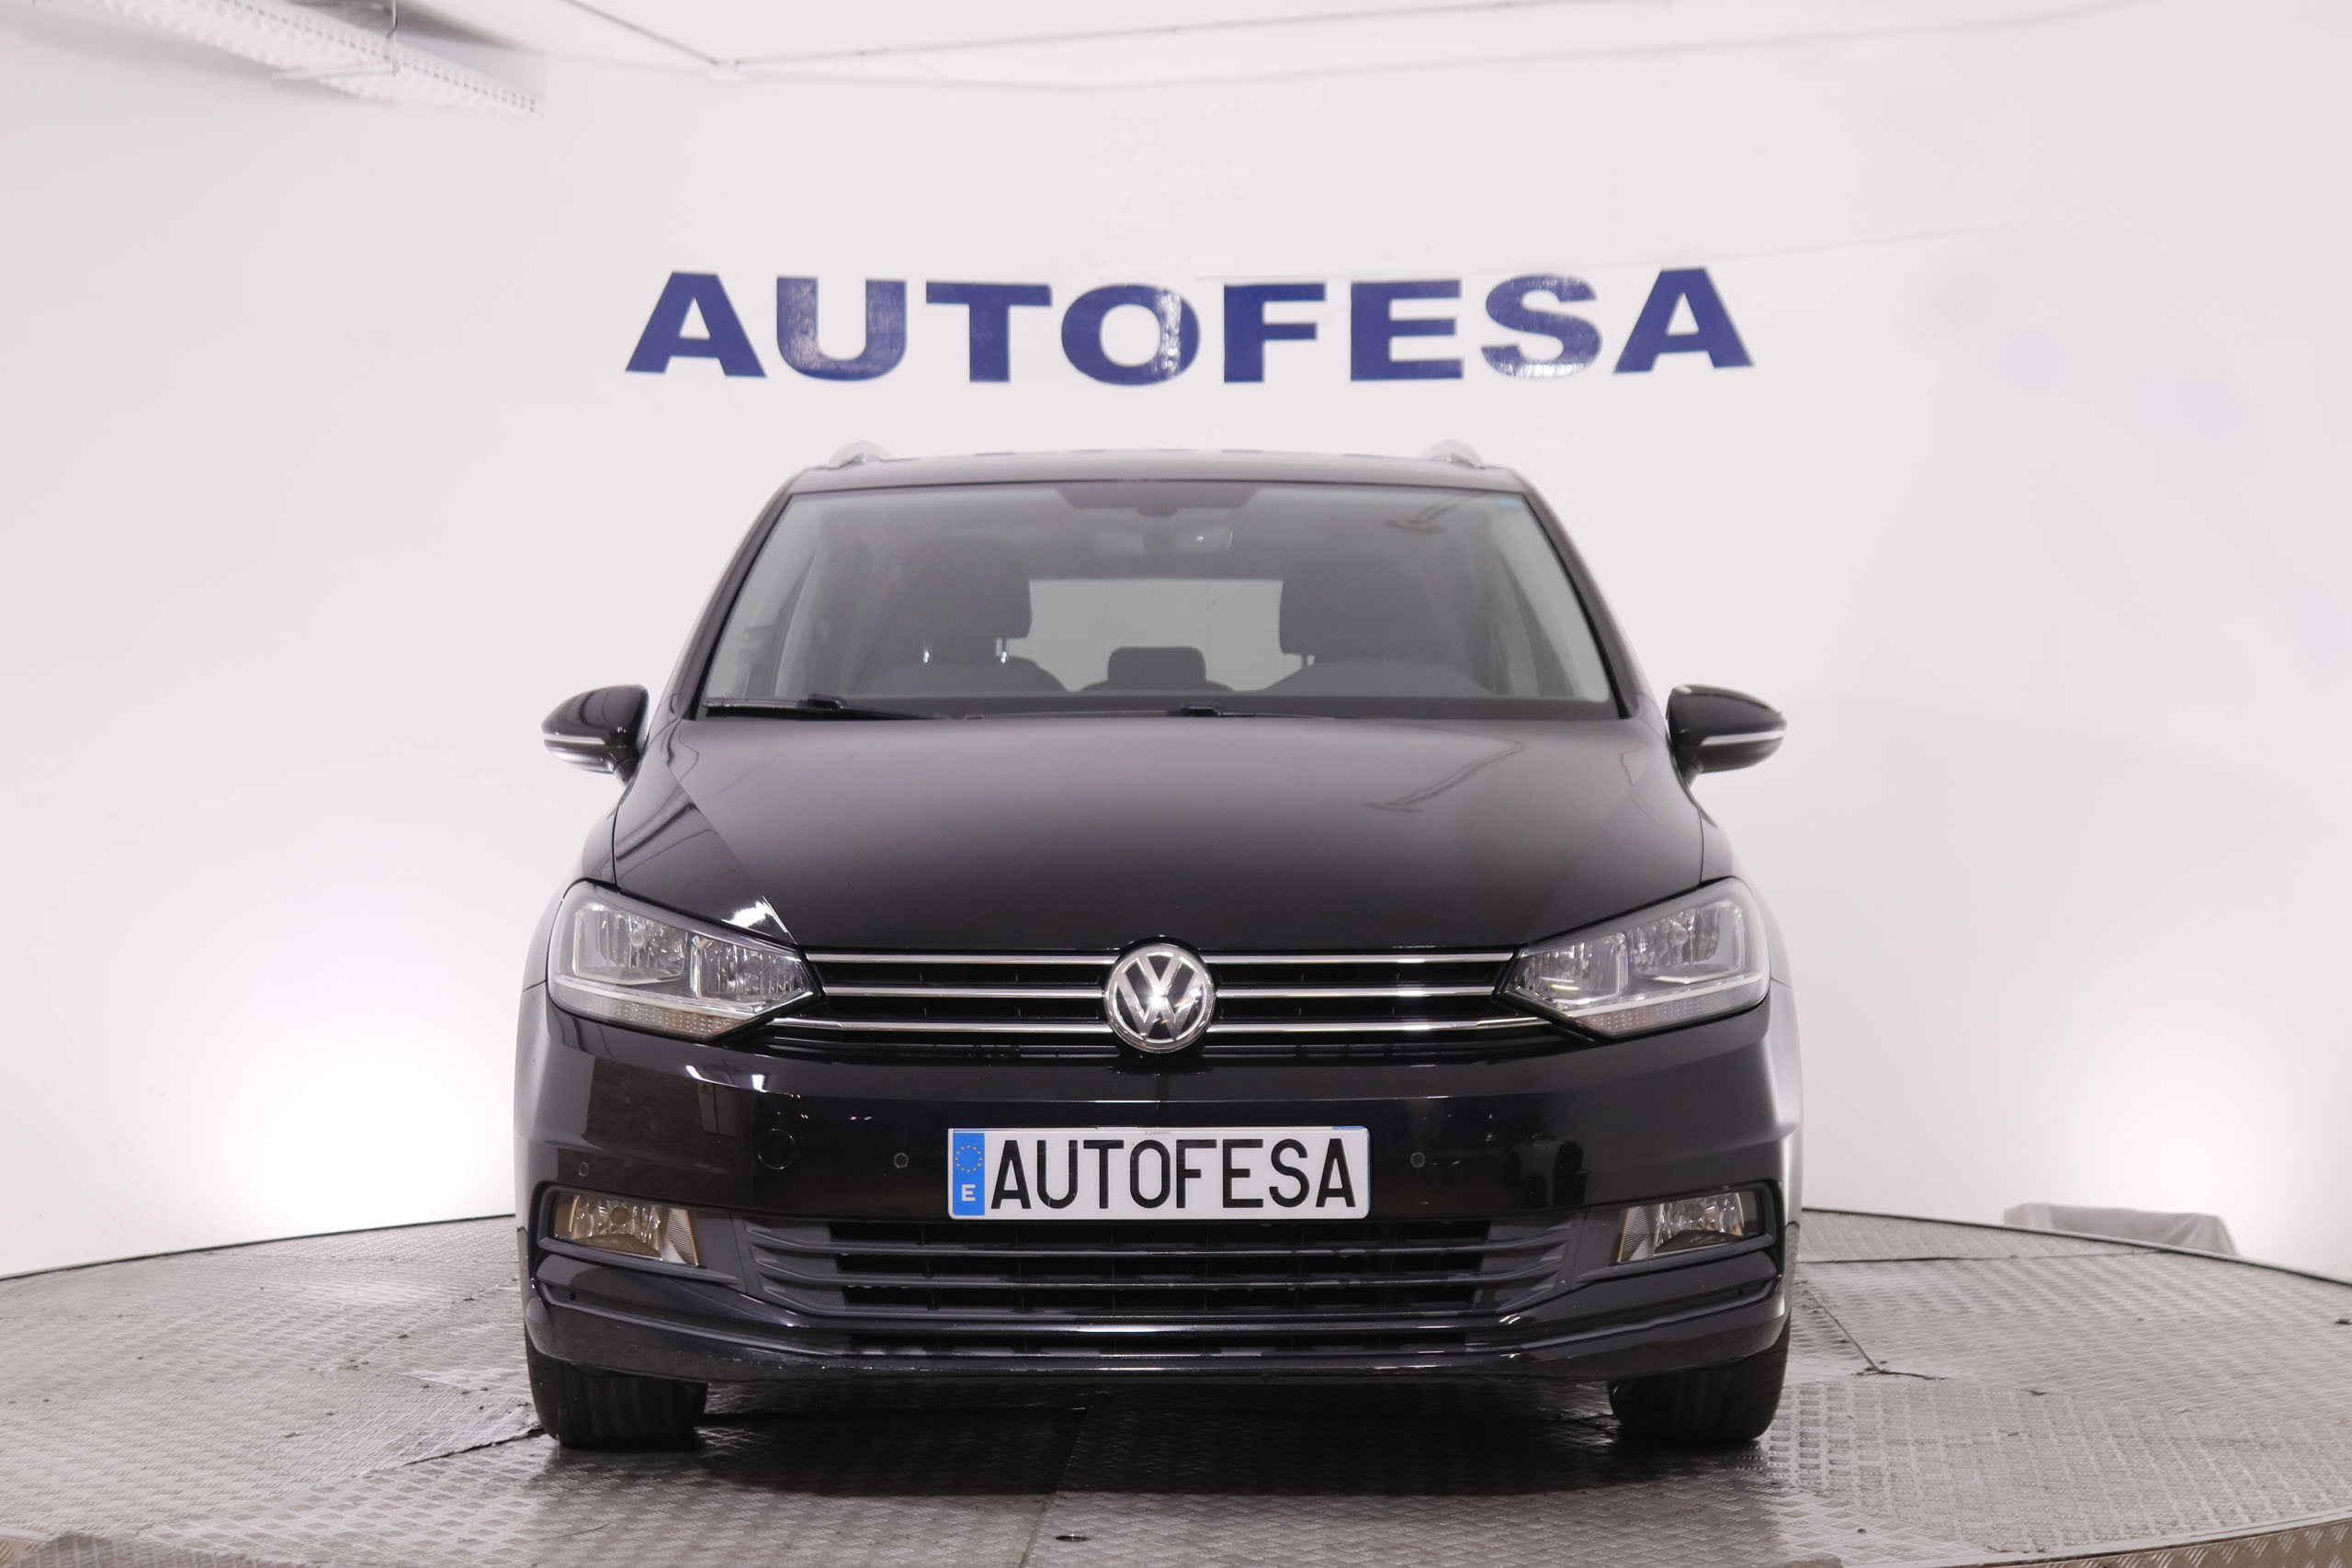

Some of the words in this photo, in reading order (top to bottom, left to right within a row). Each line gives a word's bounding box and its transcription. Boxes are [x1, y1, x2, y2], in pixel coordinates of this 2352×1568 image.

[626, 267, 1752, 386] AUTOFESA
[1111, 949, 1209, 1043] VW
[961, 1184, 977, 1202] E
[990, 1138, 1356, 1210] AUTOFESA
